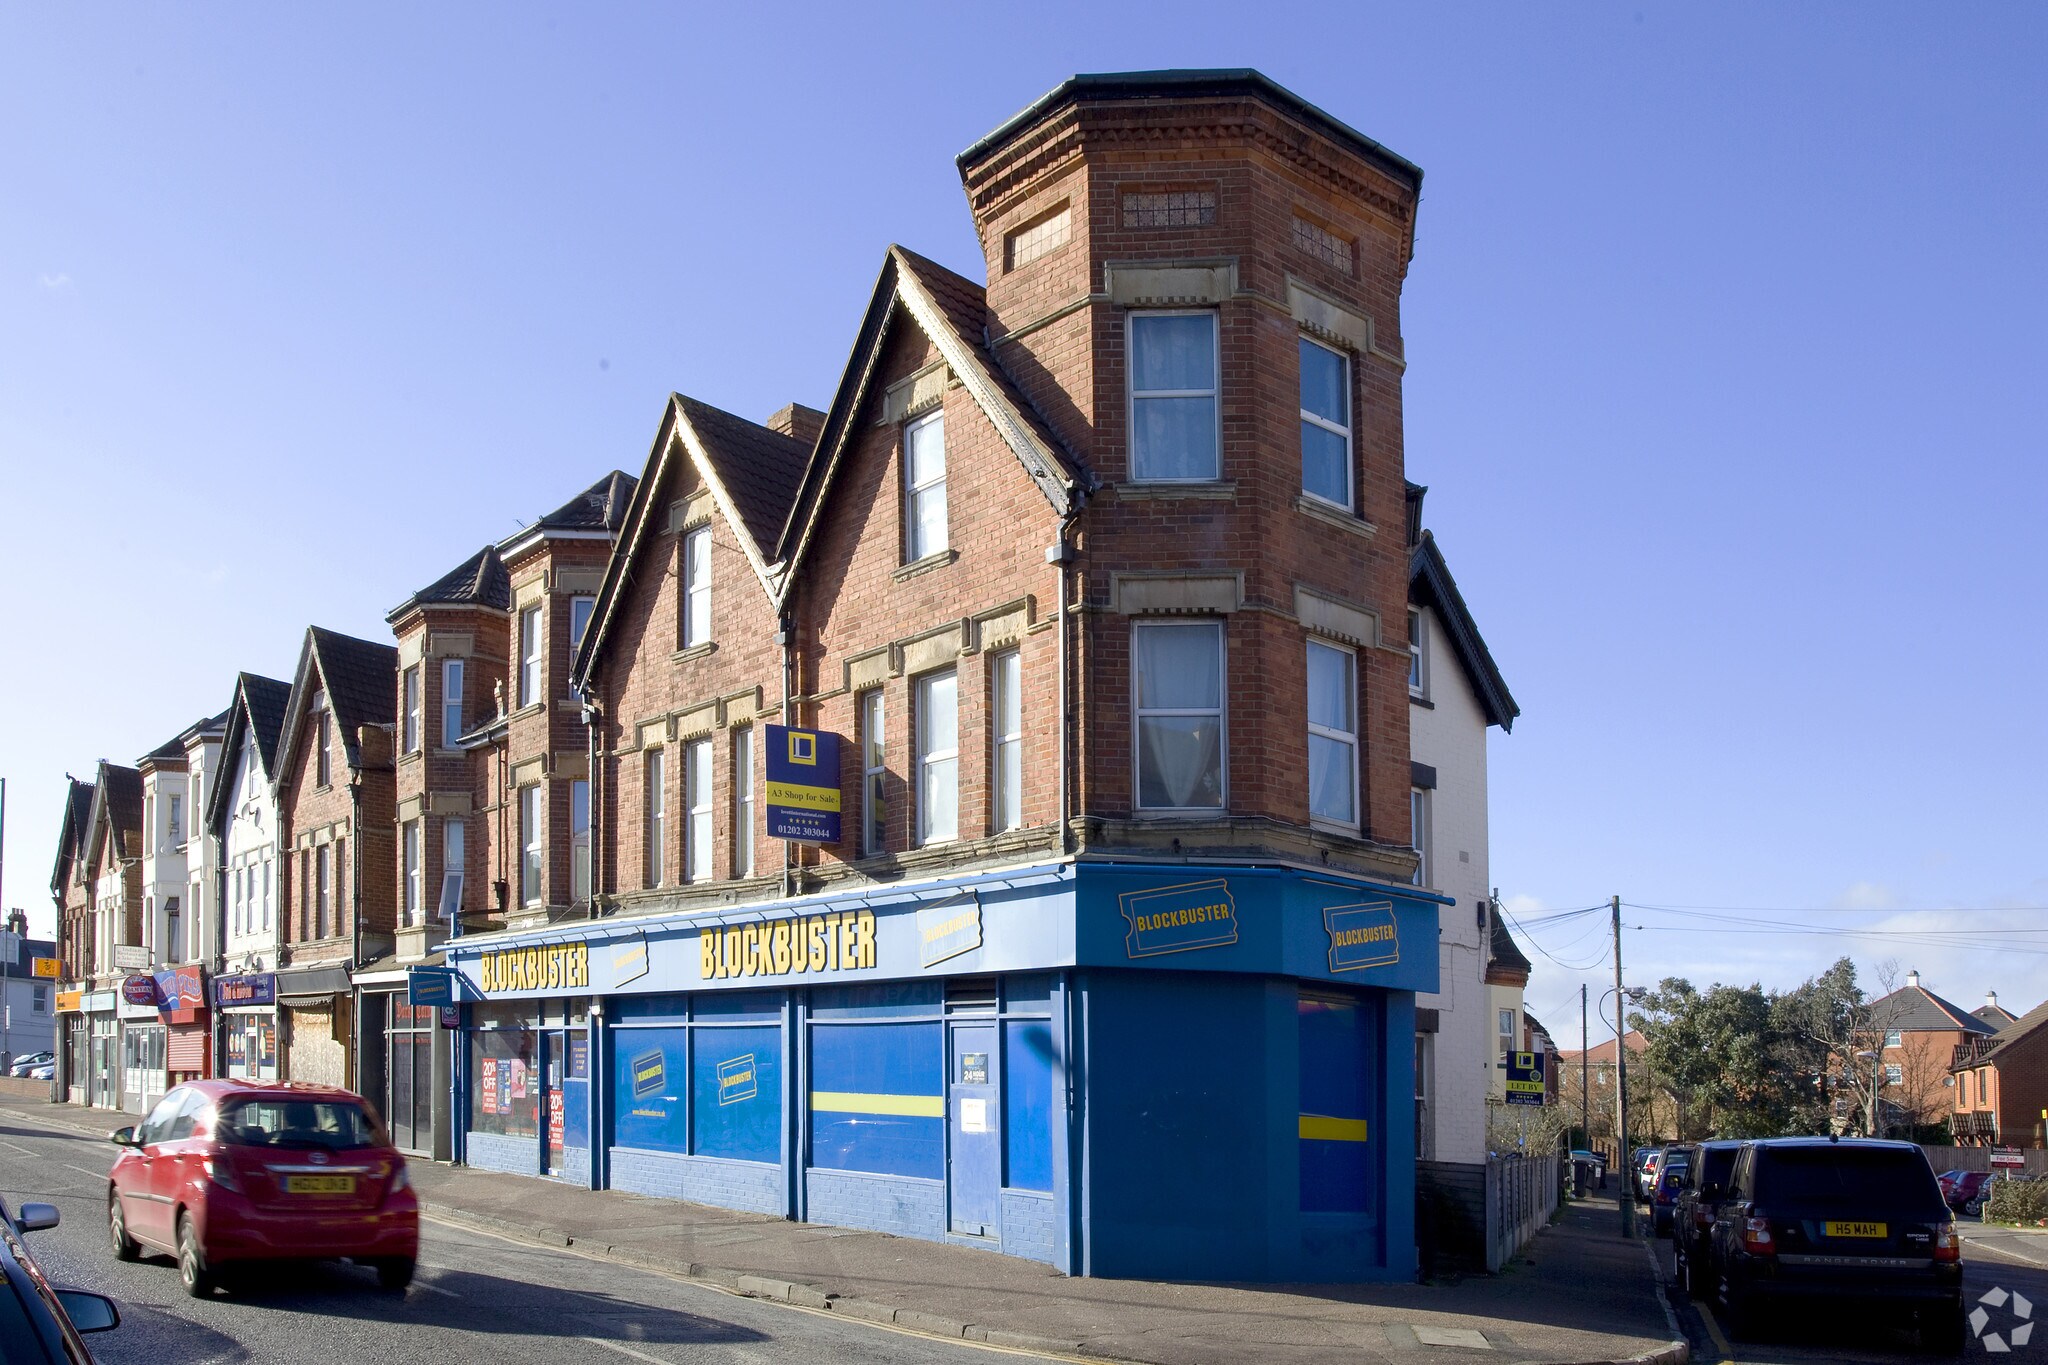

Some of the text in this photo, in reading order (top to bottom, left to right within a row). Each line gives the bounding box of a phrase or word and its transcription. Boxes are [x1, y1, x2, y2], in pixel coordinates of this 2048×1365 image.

[772, 789, 836, 804] A3 Shop for Sale
[777, 824, 830, 838] 01202 303044
[1136, 903, 1230, 933] BLOCKBUSTER
[926, 910, 977, 943] BLOCKBUSTER
[1335, 924, 1395, 947] BLOCKBUSTER
[700, 909, 878, 980] BLOCKBUSTER
[481, 941, 590, 993] BLOCKBUSTER
[483, 1061, 496, 1077] 20%
[637, 1063, 663, 1083] BLOCKBUSTER
[963, 1070, 973, 1081] 24
[483, 1077, 496, 1090] OFF
[723, 1069, 753, 1089] BLOCKBUSTER
[1511, 1082, 1539, 1091] LET BY
[550, 1094, 563, 1110] 20%
[550, 1111, 563, 1125] OFF
[1835, 1223, 1878, 1236] H5 MAH
